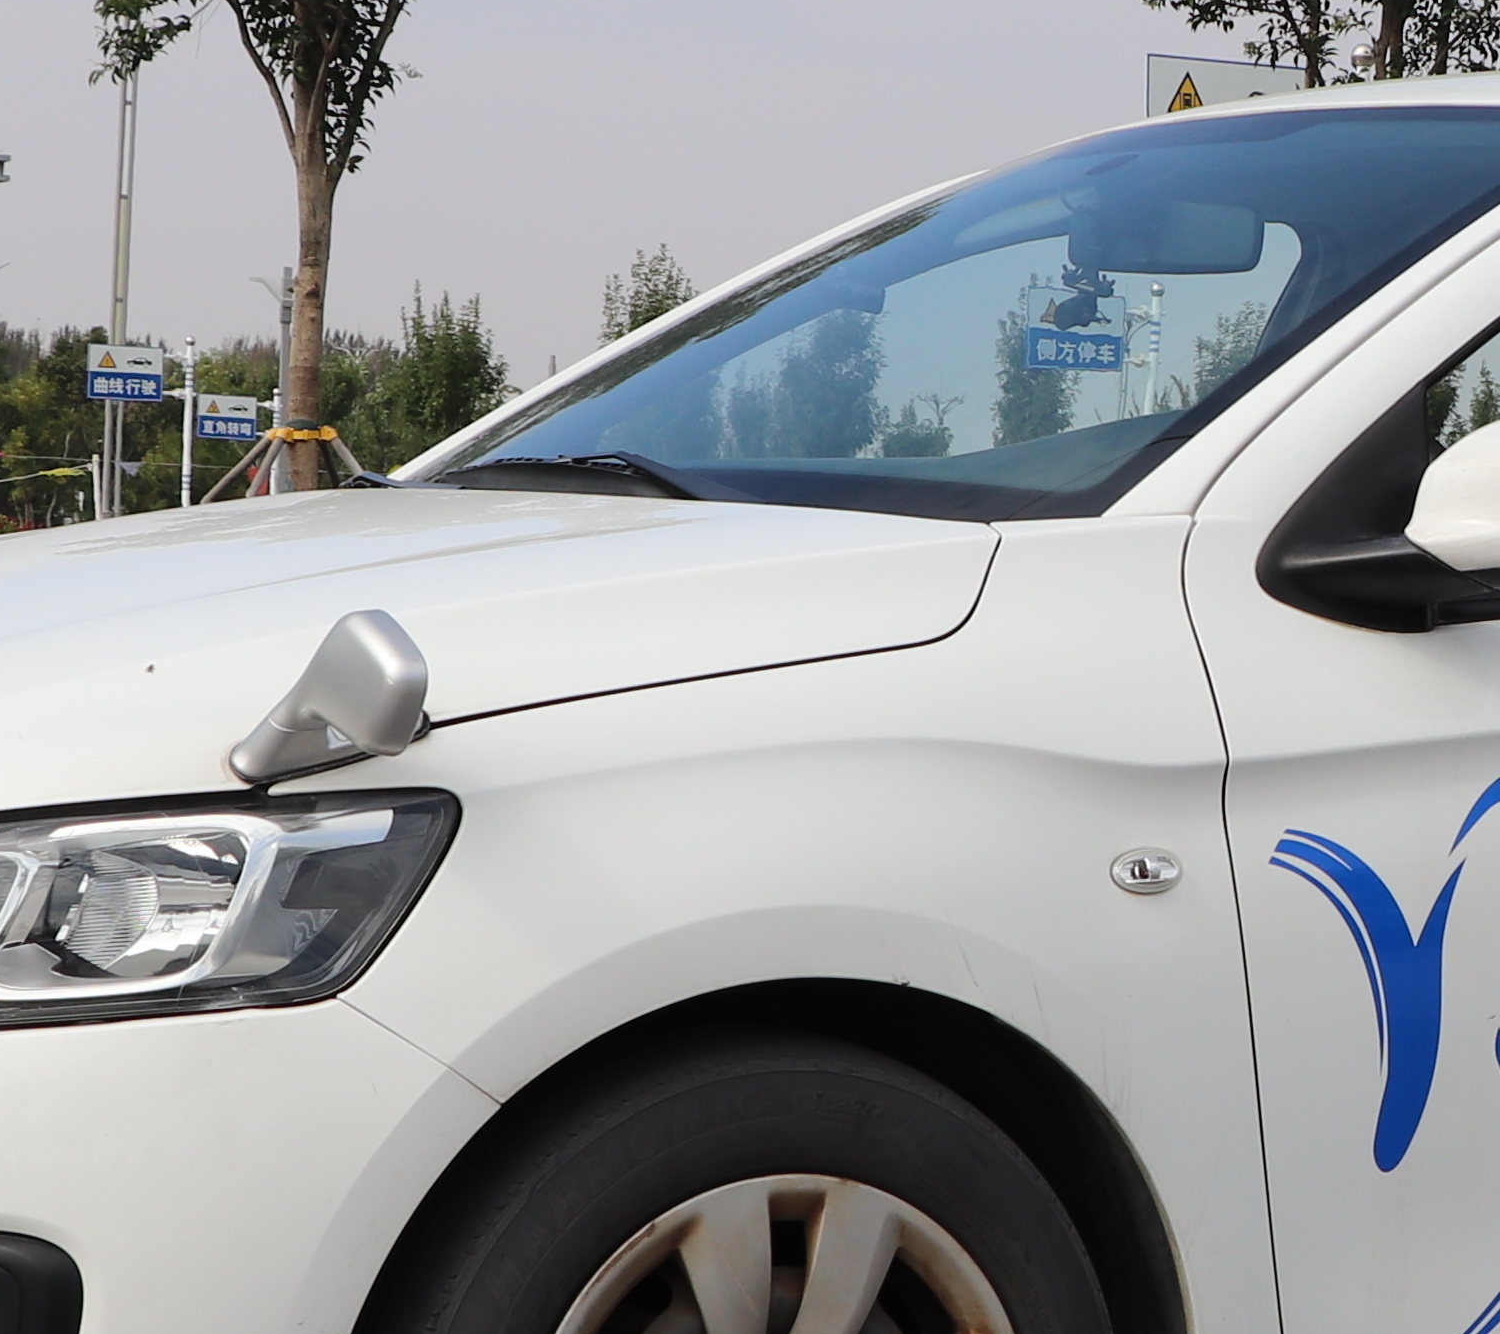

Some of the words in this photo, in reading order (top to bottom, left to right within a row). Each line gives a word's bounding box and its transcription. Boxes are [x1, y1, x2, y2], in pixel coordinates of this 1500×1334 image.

[1036, 338, 1116, 365] 侧方停车
[93, 376, 158, 396] 曲线行驶
[202, 419, 253, 436] 直角转弯
